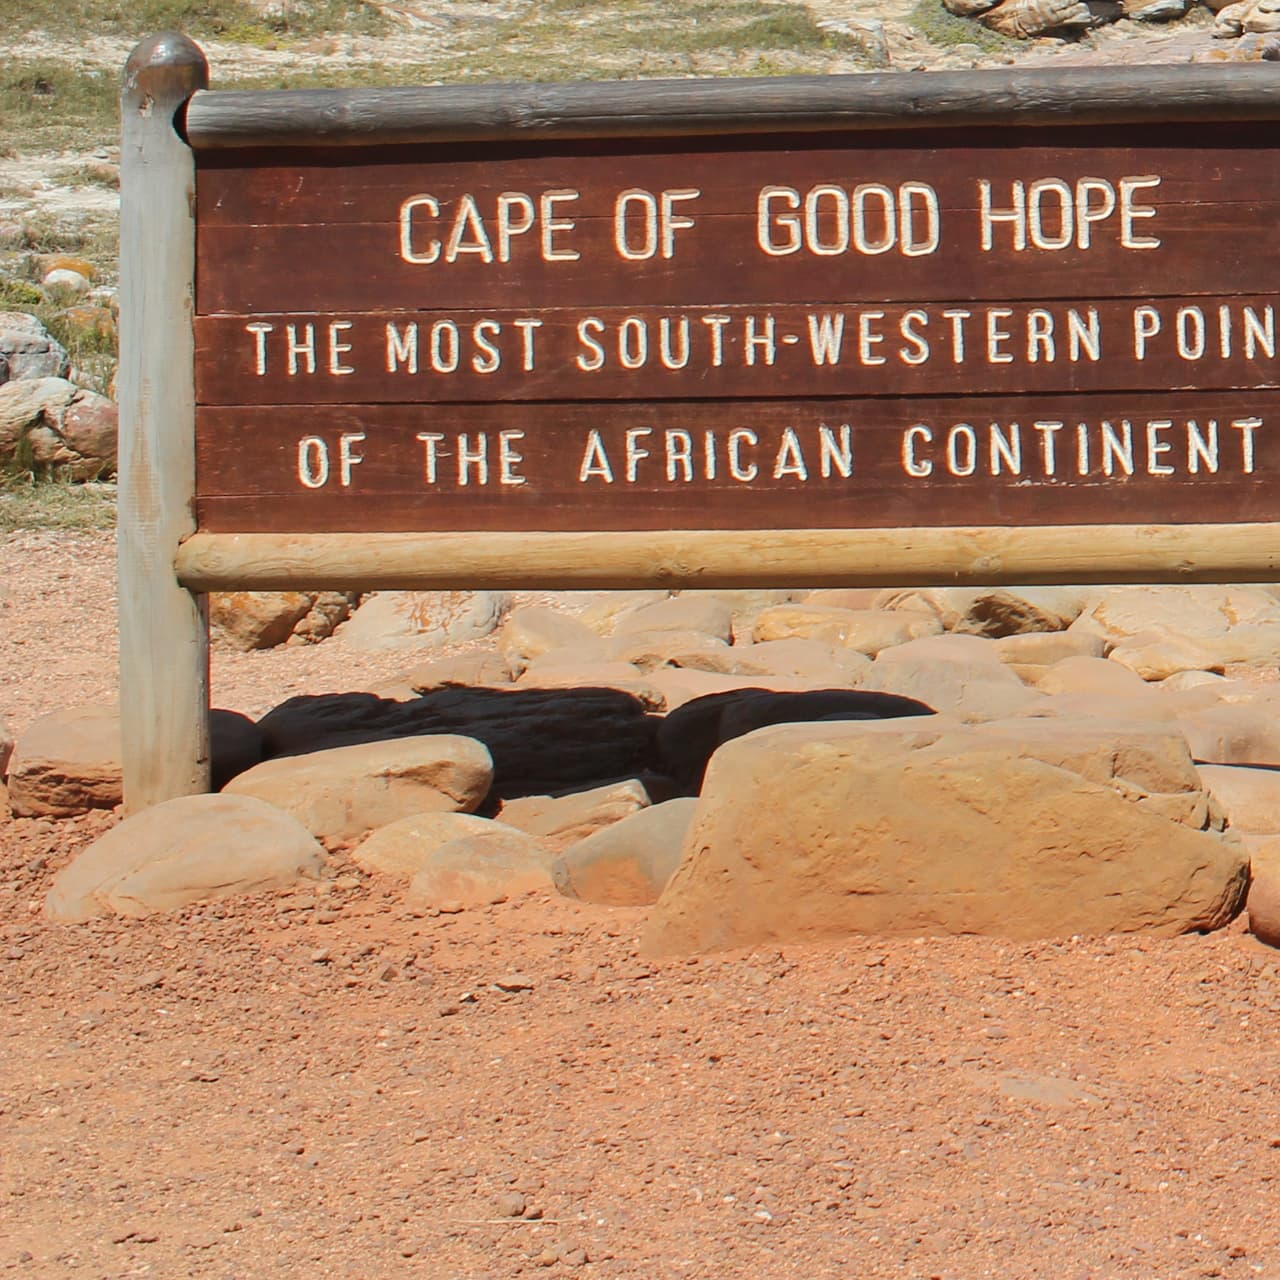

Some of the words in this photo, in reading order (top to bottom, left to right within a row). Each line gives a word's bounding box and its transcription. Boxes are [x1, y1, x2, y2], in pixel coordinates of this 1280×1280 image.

[398, 190, 582, 265] CAPE
[614, 186, 702, 261] OF
[756, 179, 941, 258] GOOD
[978, 173, 1162, 252] HOPE
[244, 319, 356, 377] THE
[385, 316, 545, 375] MOST
[575, 308, 1102, 373] SOUTH-WESTERN
[297, 430, 367, 490] OF
[415, 428, 527, 487] THE
[578, 422, 854, 485] AFRICAN
[902, 415, 1264, 478] CONTINENT
